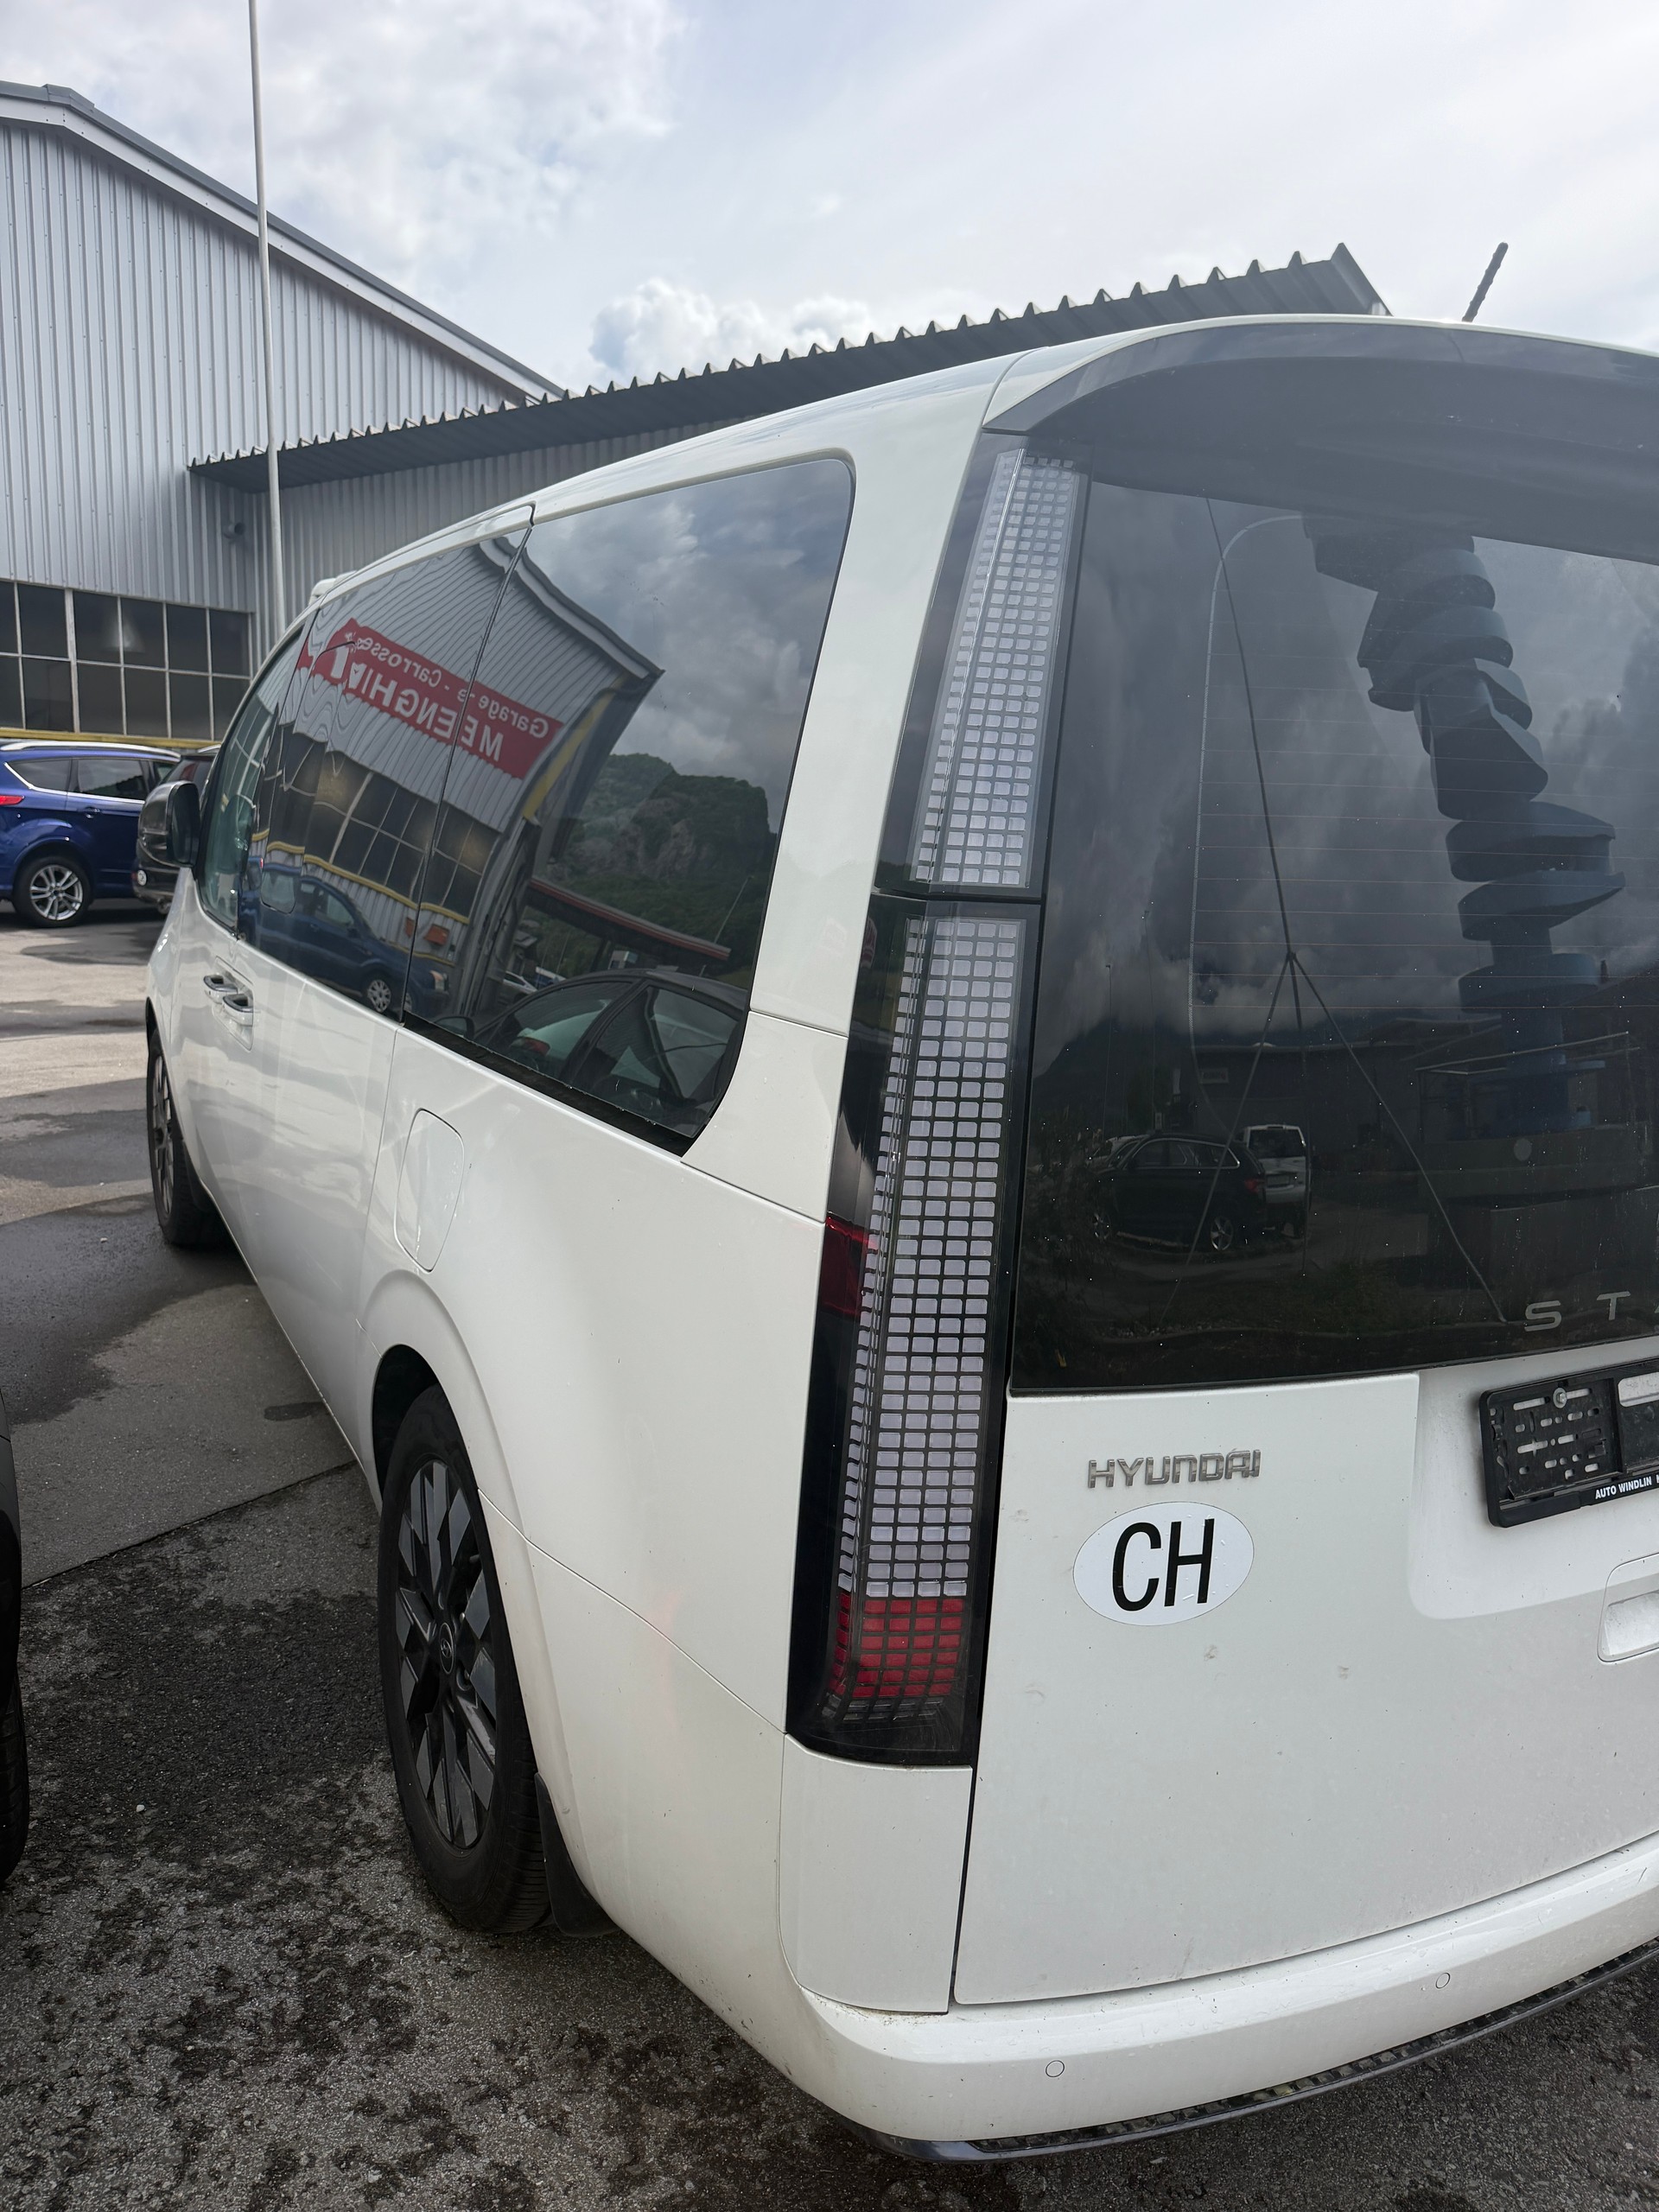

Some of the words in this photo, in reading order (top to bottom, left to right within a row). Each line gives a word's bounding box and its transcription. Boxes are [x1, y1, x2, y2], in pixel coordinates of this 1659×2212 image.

[1524, 1291, 1659, 1332] ST
[1087, 1449, 1262, 1489] HYUNDAI
[1595, 1485, 1617, 1499] AUTO
[1618, 1476, 1652, 1493] WINDLIN
[1112, 1518, 1215, 1611] CH
